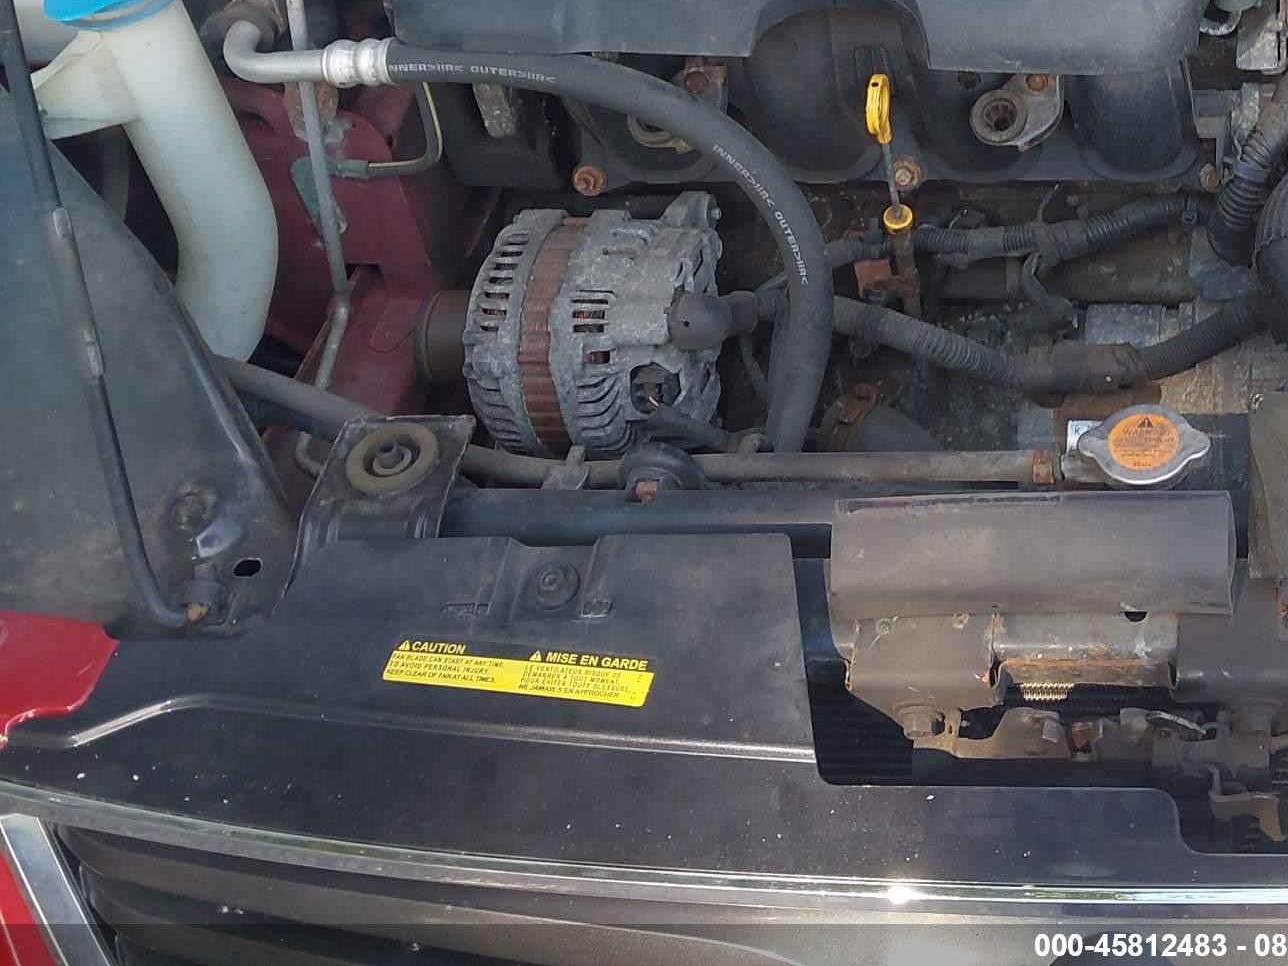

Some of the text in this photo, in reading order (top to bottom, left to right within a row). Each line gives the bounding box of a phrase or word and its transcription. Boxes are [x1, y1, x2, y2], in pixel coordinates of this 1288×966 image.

[411, 641, 467, 655] CAUTION
[444, 657, 463, 665] START
[545, 651, 649, 671] MISE EN GARDE
[423, 663, 460, 673] PERSONAL
[536, 665, 583, 675] VENTILATEUR
[520, 676, 540, 684] POUR
[569, 681, 591, 689] TOUTE
[570, 674, 587, 683] TOUT
[529, 684, 557, 692] JAMAIS
[575, 688, 620, 698] APPROCHER
